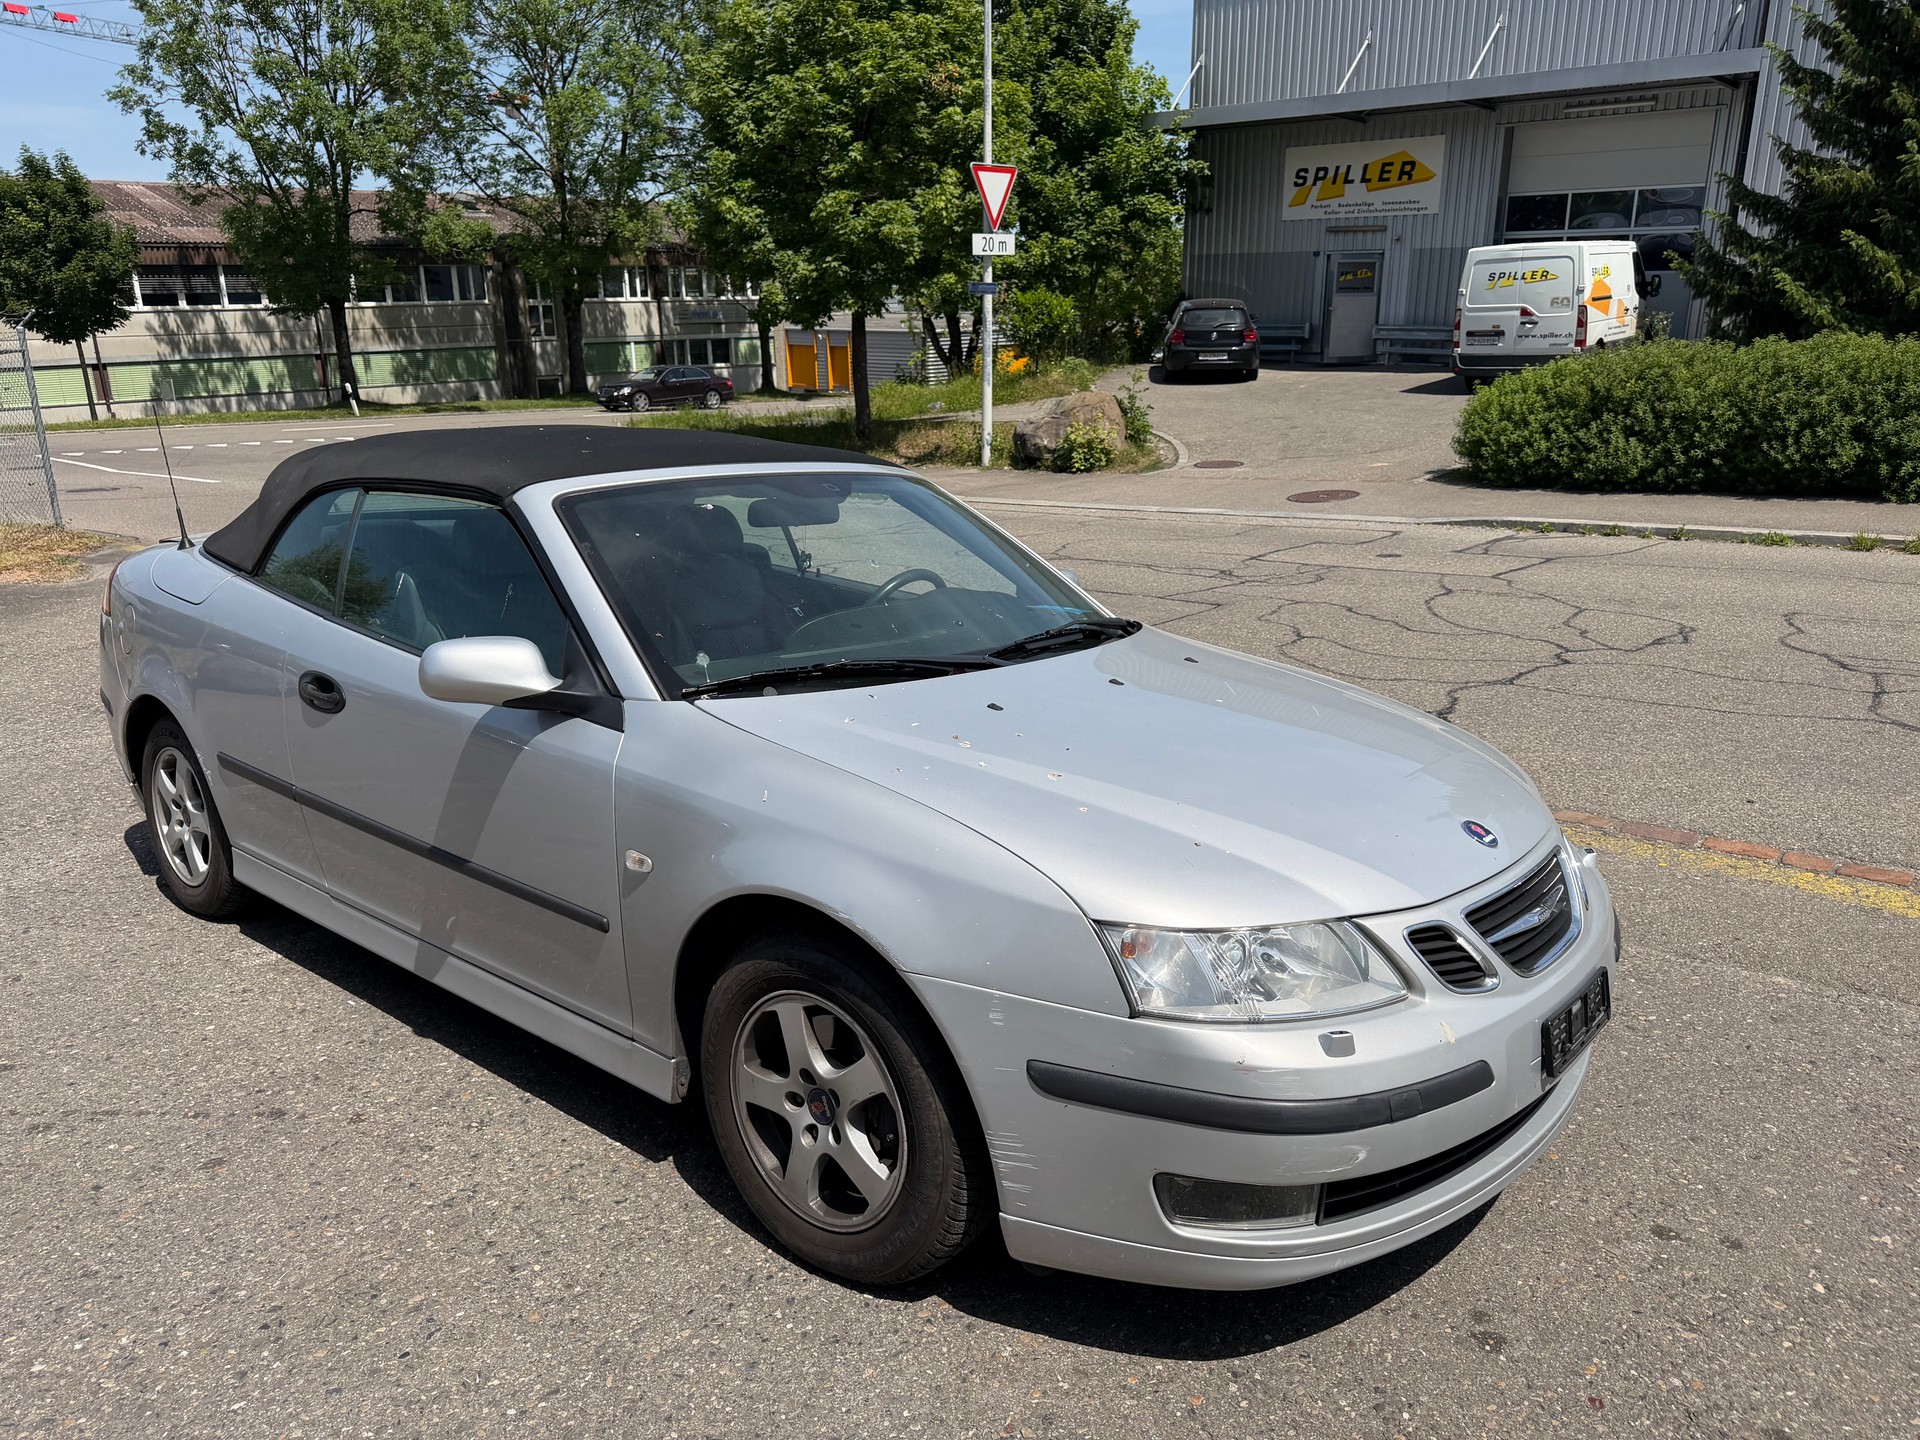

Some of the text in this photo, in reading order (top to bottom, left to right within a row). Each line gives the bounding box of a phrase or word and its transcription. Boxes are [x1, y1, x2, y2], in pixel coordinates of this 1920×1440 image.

[1293, 160, 1416, 187] SPILLER
[982, 236, 1007, 252] 20 m
[1487, 270, 1549, 282] SPILLER
[1517, 332, 1573, 340] www.spiller.ch
